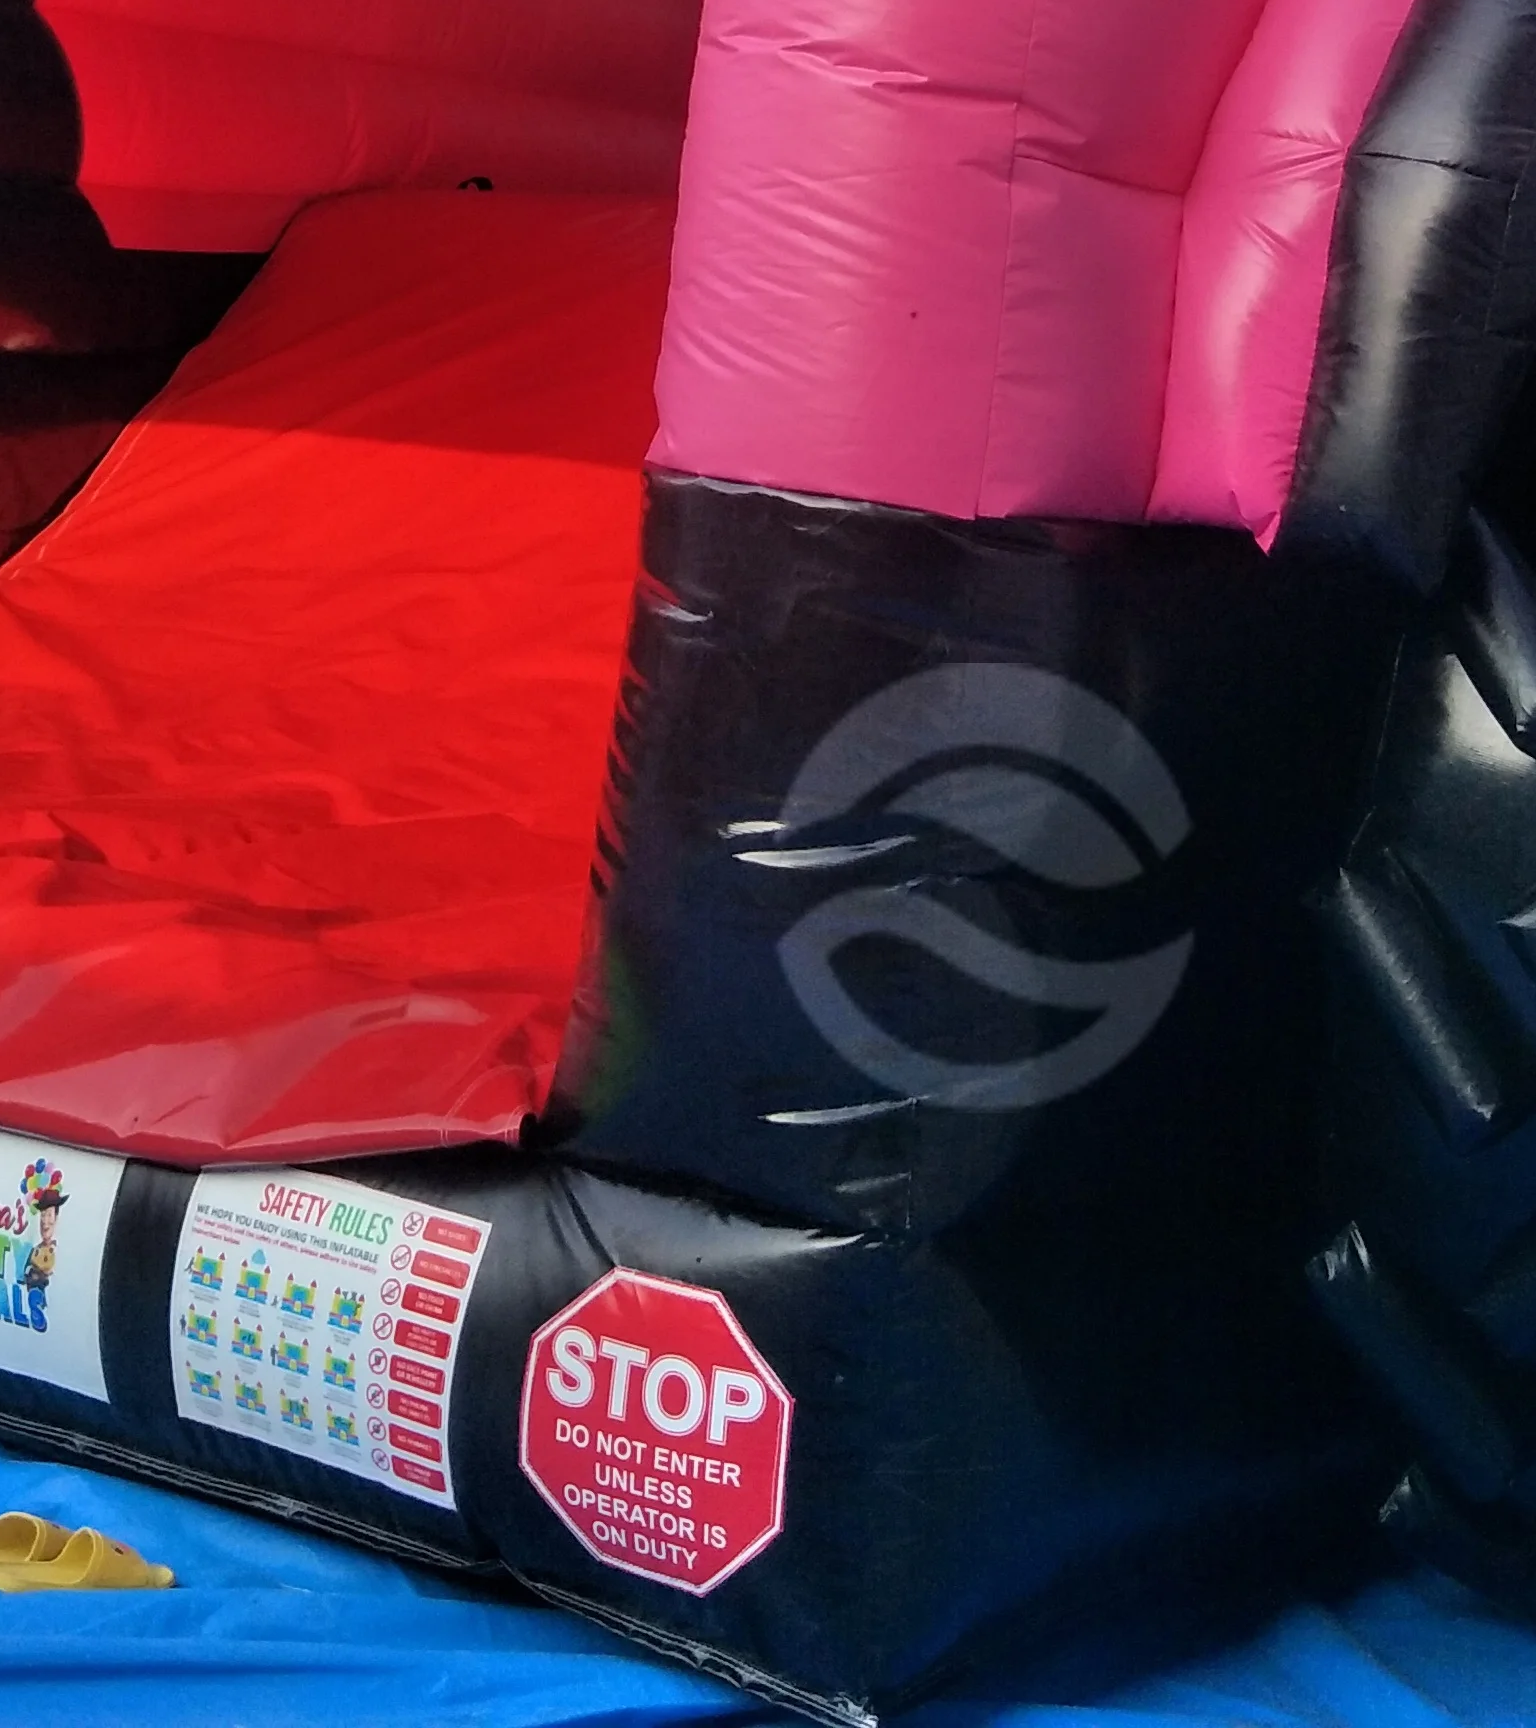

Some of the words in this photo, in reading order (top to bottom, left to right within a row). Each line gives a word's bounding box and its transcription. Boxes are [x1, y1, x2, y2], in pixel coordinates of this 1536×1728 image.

[197, 1203, 209, 1214] WE
[211, 1207, 232, 1222] HOPE
[236, 1213, 251, 1226] YOU
[253, 1219, 279, 1234] ENJOY
[281, 1226, 306, 1243] USING
[310, 1235, 327, 1249] THIS
[330, 1242, 379, 1264] INFLATABLE
[259, 1183, 332, 1227] SAFETY
[329, 1203, 393, 1245] RULES
[546, 1326, 766, 1445] STOP
[556, 1419, 589, 1448] DO
[597, 1431, 647, 1465] NOT
[654, 1448, 741, 1487] ENTER
[564, 1484, 696, 1542] OPERATOR
[703, 1524, 727, 1548] IS
[595, 1463, 692, 1509] UNLESS
[593, 1521, 627, 1548] ON
[634, 1533, 698, 1570] DUTY
